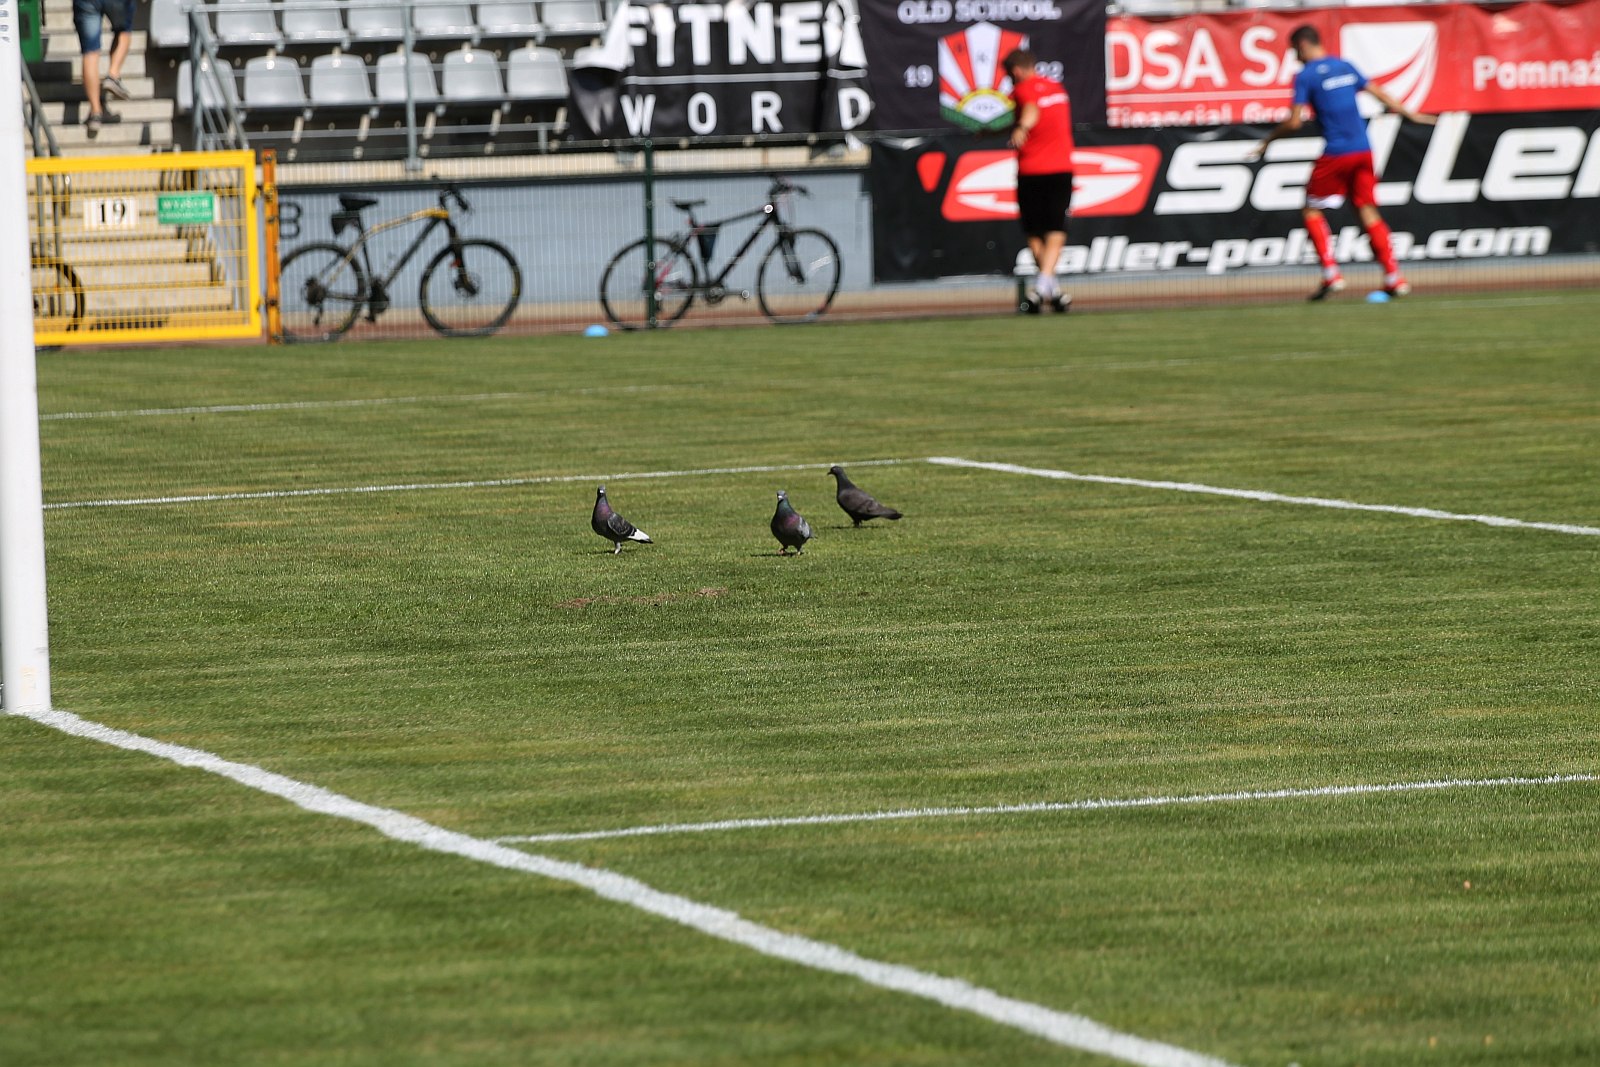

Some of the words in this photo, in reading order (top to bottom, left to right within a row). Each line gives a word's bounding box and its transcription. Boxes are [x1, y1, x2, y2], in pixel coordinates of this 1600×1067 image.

[897, 0, 952, 24] OLD
[955, 0, 1063, 22] SCHOOL
[1104, 28, 1229, 91] DSA
[904, 64, 934, 88] 19
[1106, 103, 1233, 128] Financial
[99, 199, 126, 225] 19
